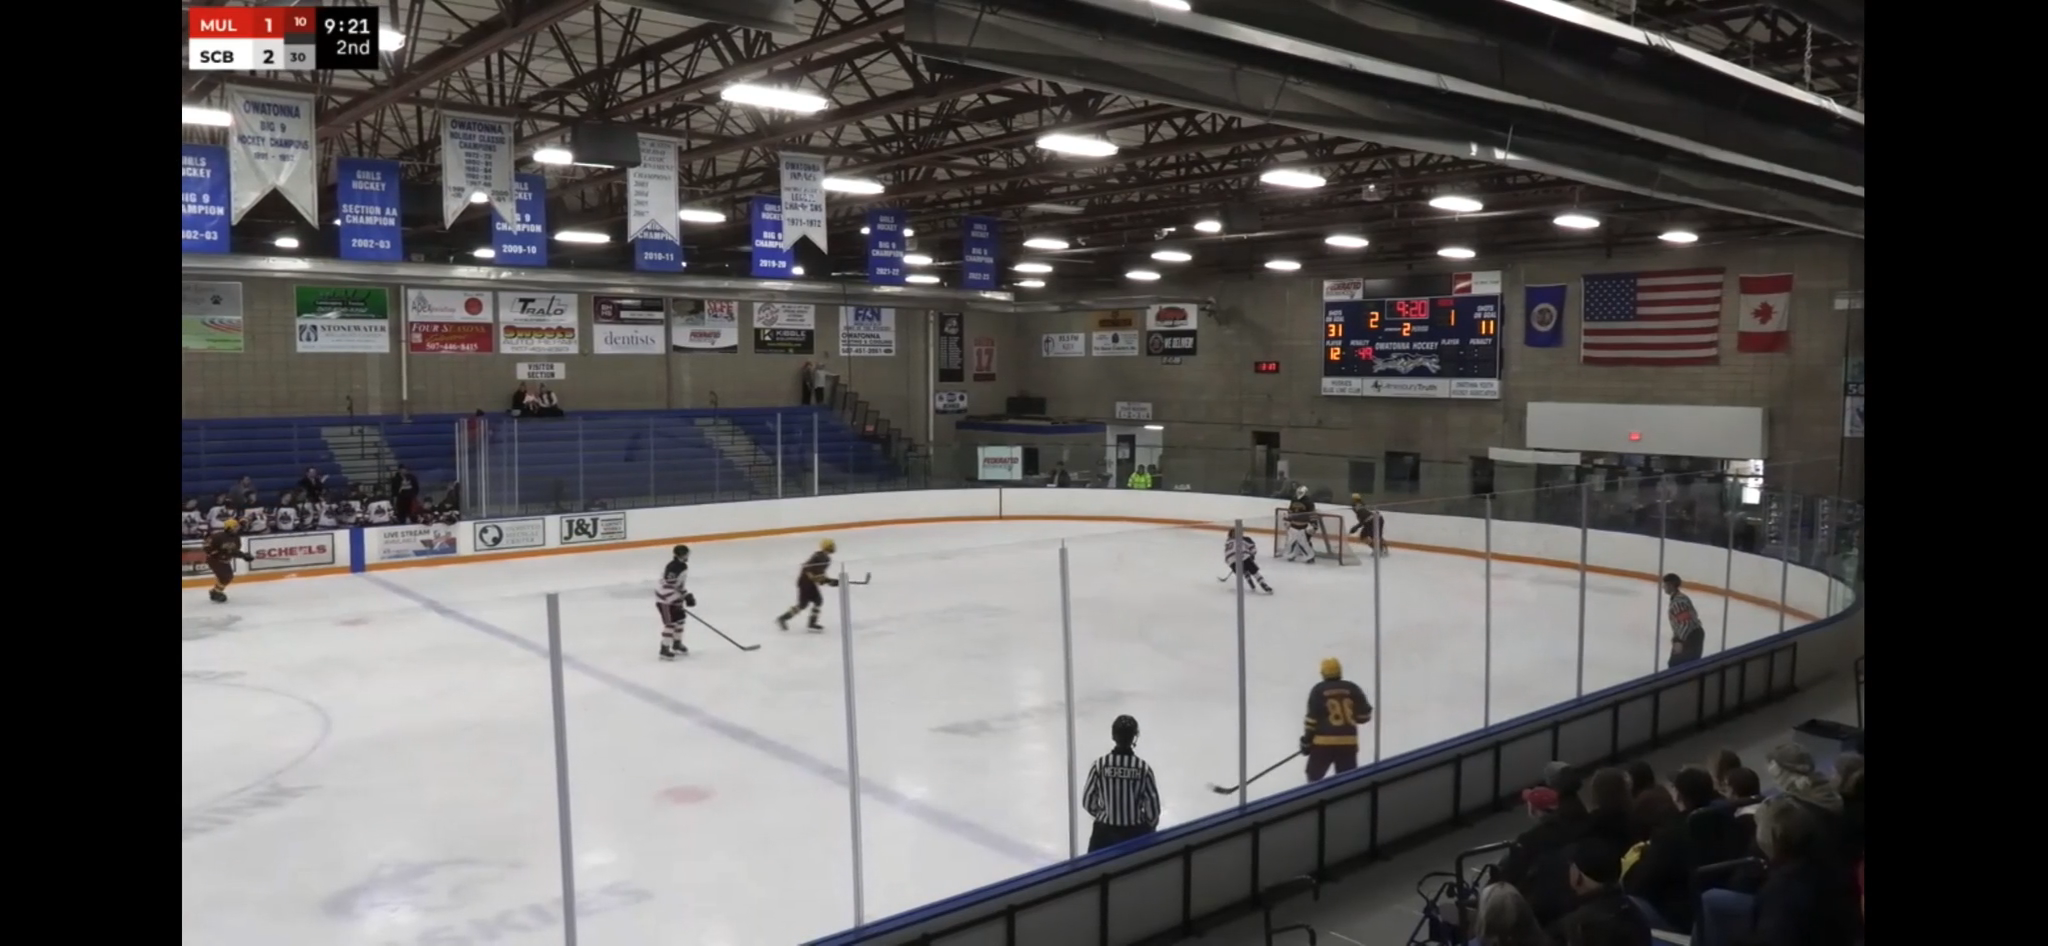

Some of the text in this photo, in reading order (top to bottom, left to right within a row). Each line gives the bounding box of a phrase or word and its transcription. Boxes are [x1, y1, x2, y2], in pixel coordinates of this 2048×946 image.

[243, 100, 301, 119] OWATONNA
[450, 119, 504, 135] OWATONNA
[182, 156, 207, 167] IRLS
[182, 167, 212, 178] OCKEY
[356, 170, 382, 181] GIRLS
[352, 180, 386, 192] HOCKEY
[182, 192, 211, 204] IG 9
[182, 204, 225, 216] AMPION
[342, 204, 398, 217] SECTION AA
[345, 214, 396, 226] CHAMPION
[761, 212, 783, 221] HOCKE
[182, 230, 219, 241] 02-03
[352, 238, 391, 250] 2002-03
[502, 245, 537, 255] 2009-10
[755, 239, 784, 249] CHAMPI
[644, 251, 674, 262] 2010-11
[1396, 300, 1429, 318] 9:20
[1369, 311, 1379, 329] 2
[320, 324, 387, 333] STONEWATER
[412, 323, 440, 332] FOUR
[1327, 323, 1343, 337] 31
[1401, 322, 1411, 336] 2
[1481, 319, 1495, 335] 11
[604, 330, 656, 346] dentists
[841, 332, 882, 340] OWATONNA
[1374, 341, 1438, 351] OWATONNA HOCKEY
[976, 348, 995, 372] 17
[1329, 347, 1341, 361] 12
[527, 363, 555, 371] VISITOR
[527, 371, 556, 379] SECTION
[383, 529, 431, 539] LIVE STREAM
[563, 517, 600, 541] J&J
